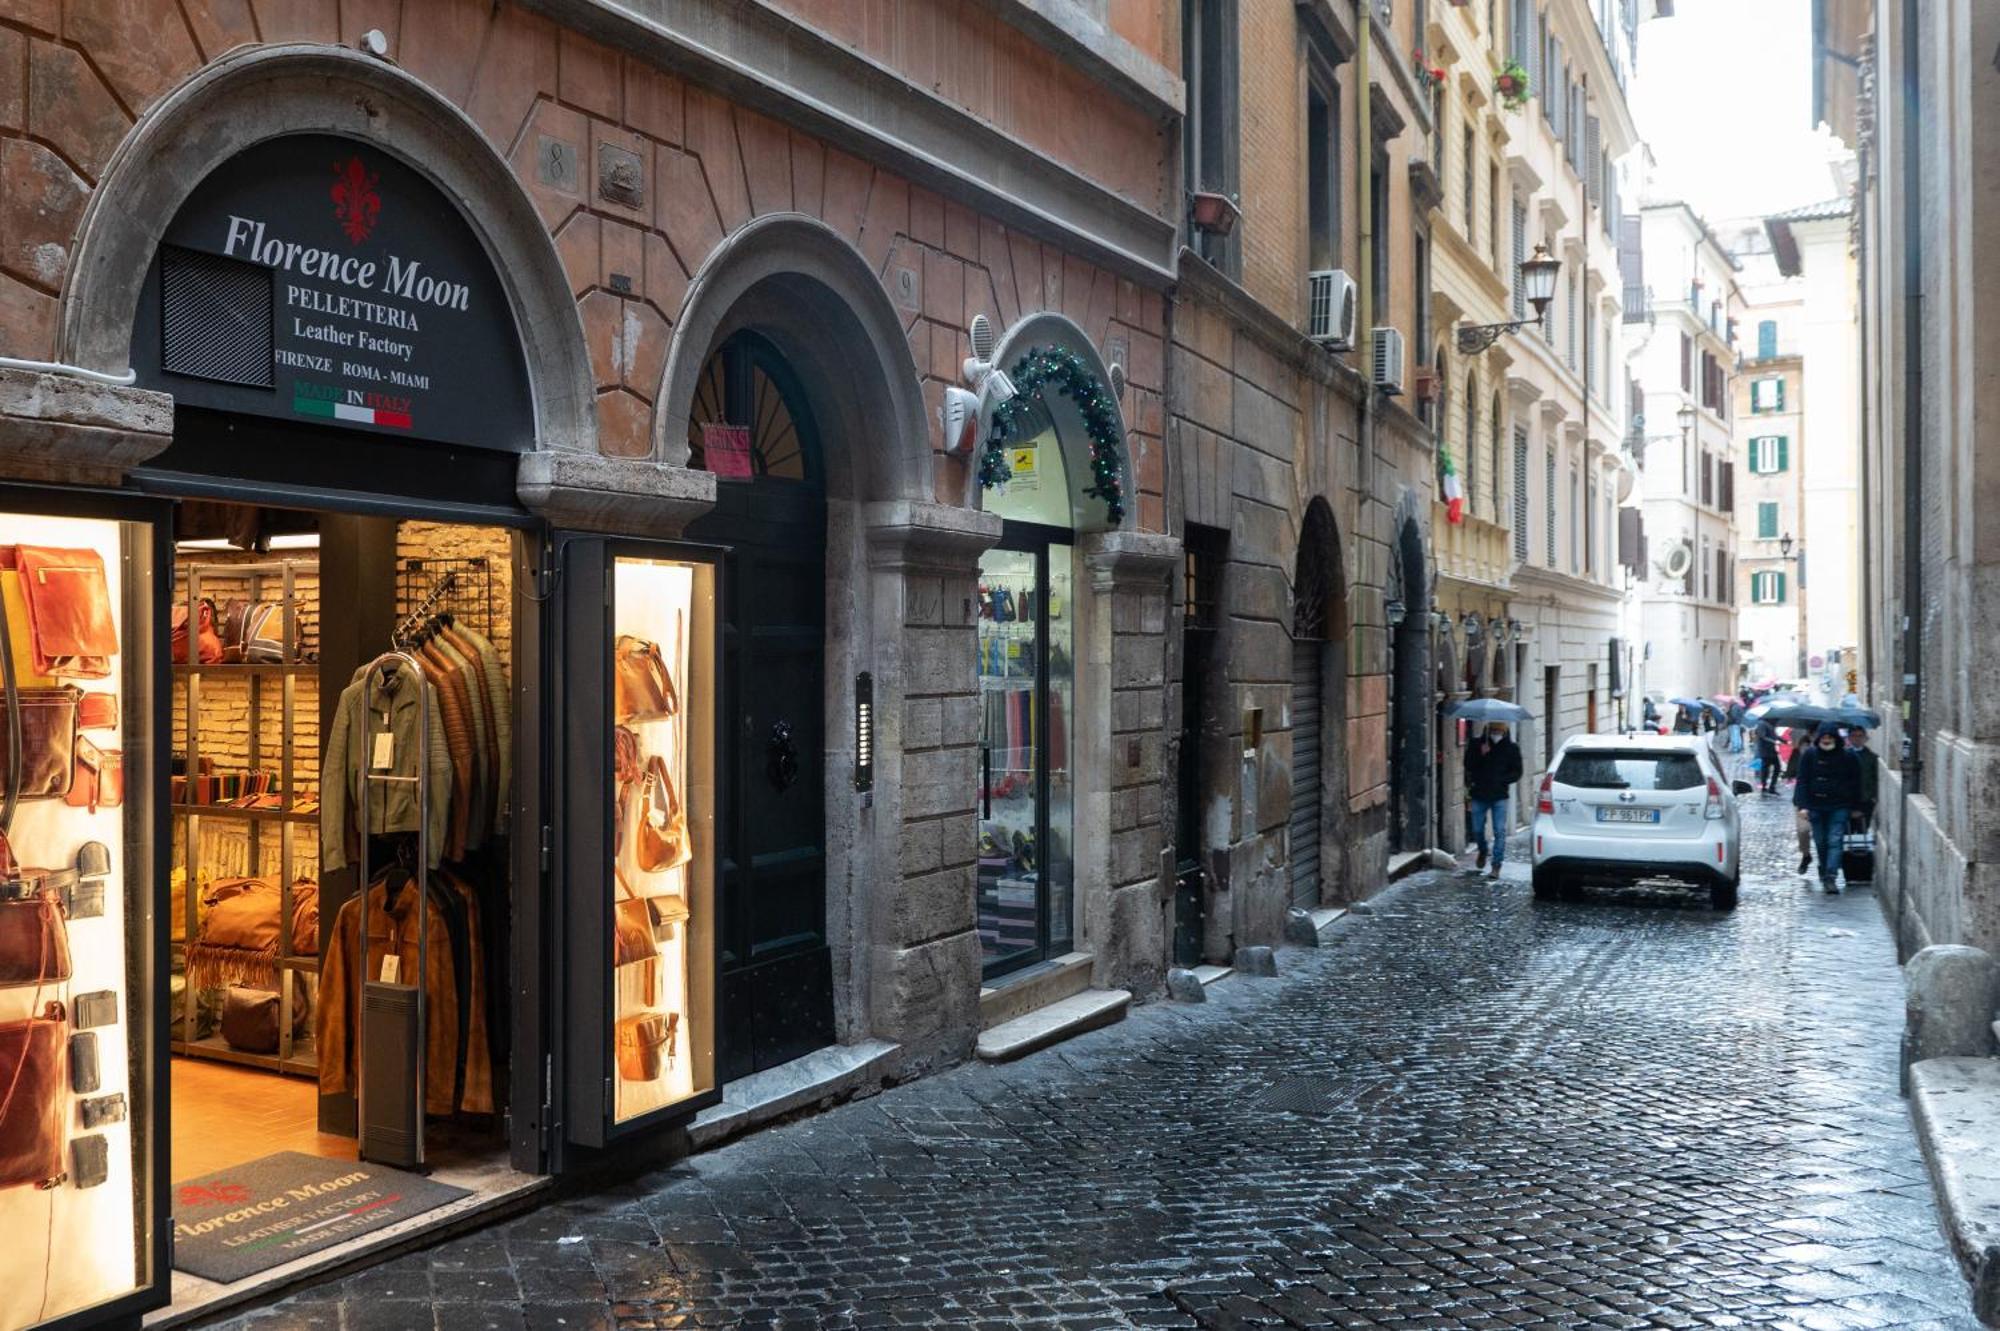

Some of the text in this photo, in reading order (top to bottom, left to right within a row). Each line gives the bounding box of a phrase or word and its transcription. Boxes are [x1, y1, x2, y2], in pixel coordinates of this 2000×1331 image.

[550, 142, 564, 180] 8
[223, 215, 470, 311] Florence Moon
[287, 285, 419, 332] PELLETTERIA
[294, 317, 413, 362] Leather Factory
[275, 350, 333, 373] FIRENZE
[343, 362, 381, 382] ROMA
[390, 371, 430, 390] MIAMI
[294, 379, 412, 412] MADE IN ITALY
[284, 1172, 371, 1201] Moon
[222, 1190, 381, 1247] LEATHER FACTORY
[282, 1229, 335, 1248] MADE
[350, 1207, 395, 1226] ITALY
